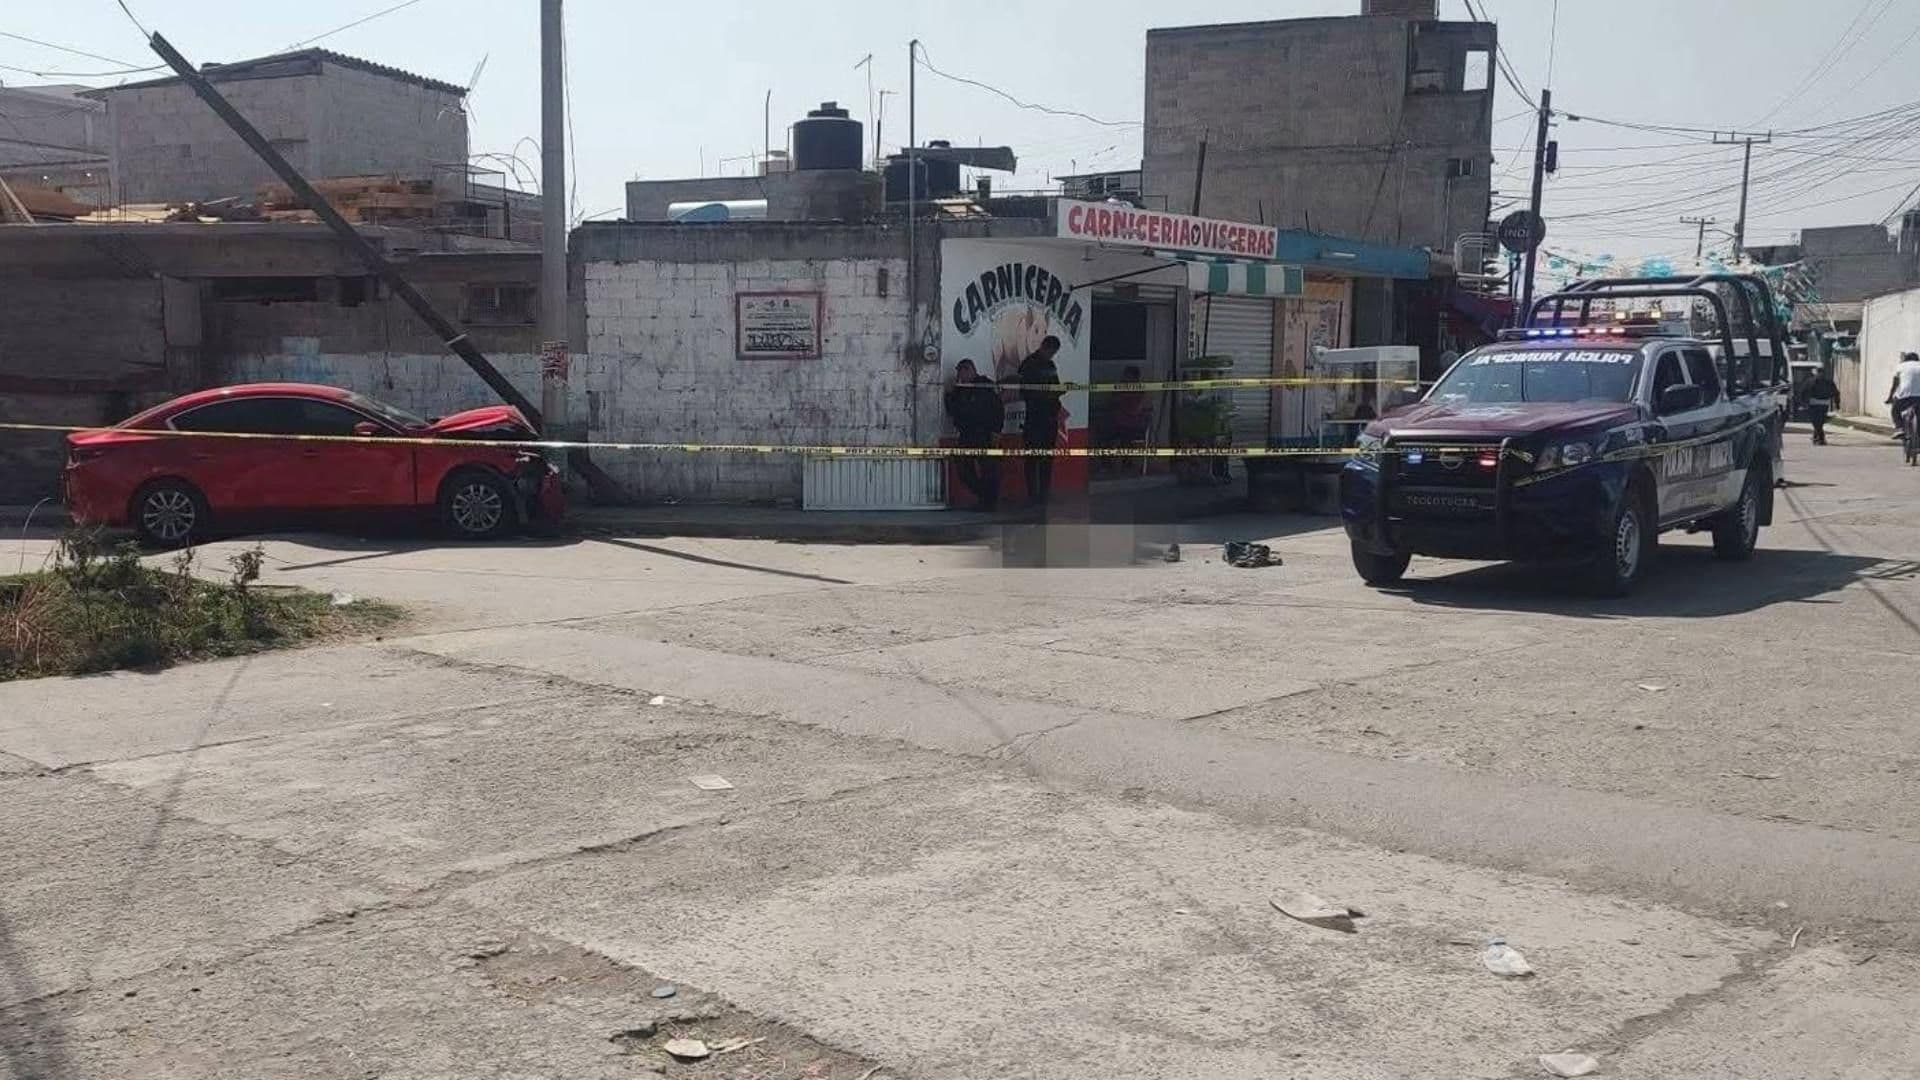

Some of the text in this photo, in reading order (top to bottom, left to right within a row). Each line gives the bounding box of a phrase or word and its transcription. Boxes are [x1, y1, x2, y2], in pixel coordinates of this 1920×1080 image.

[1068, 205, 1190, 246] CARNICERIA
[1202, 221, 1275, 256] VISCERAS
[952, 262, 1083, 340] CARNICERIA
